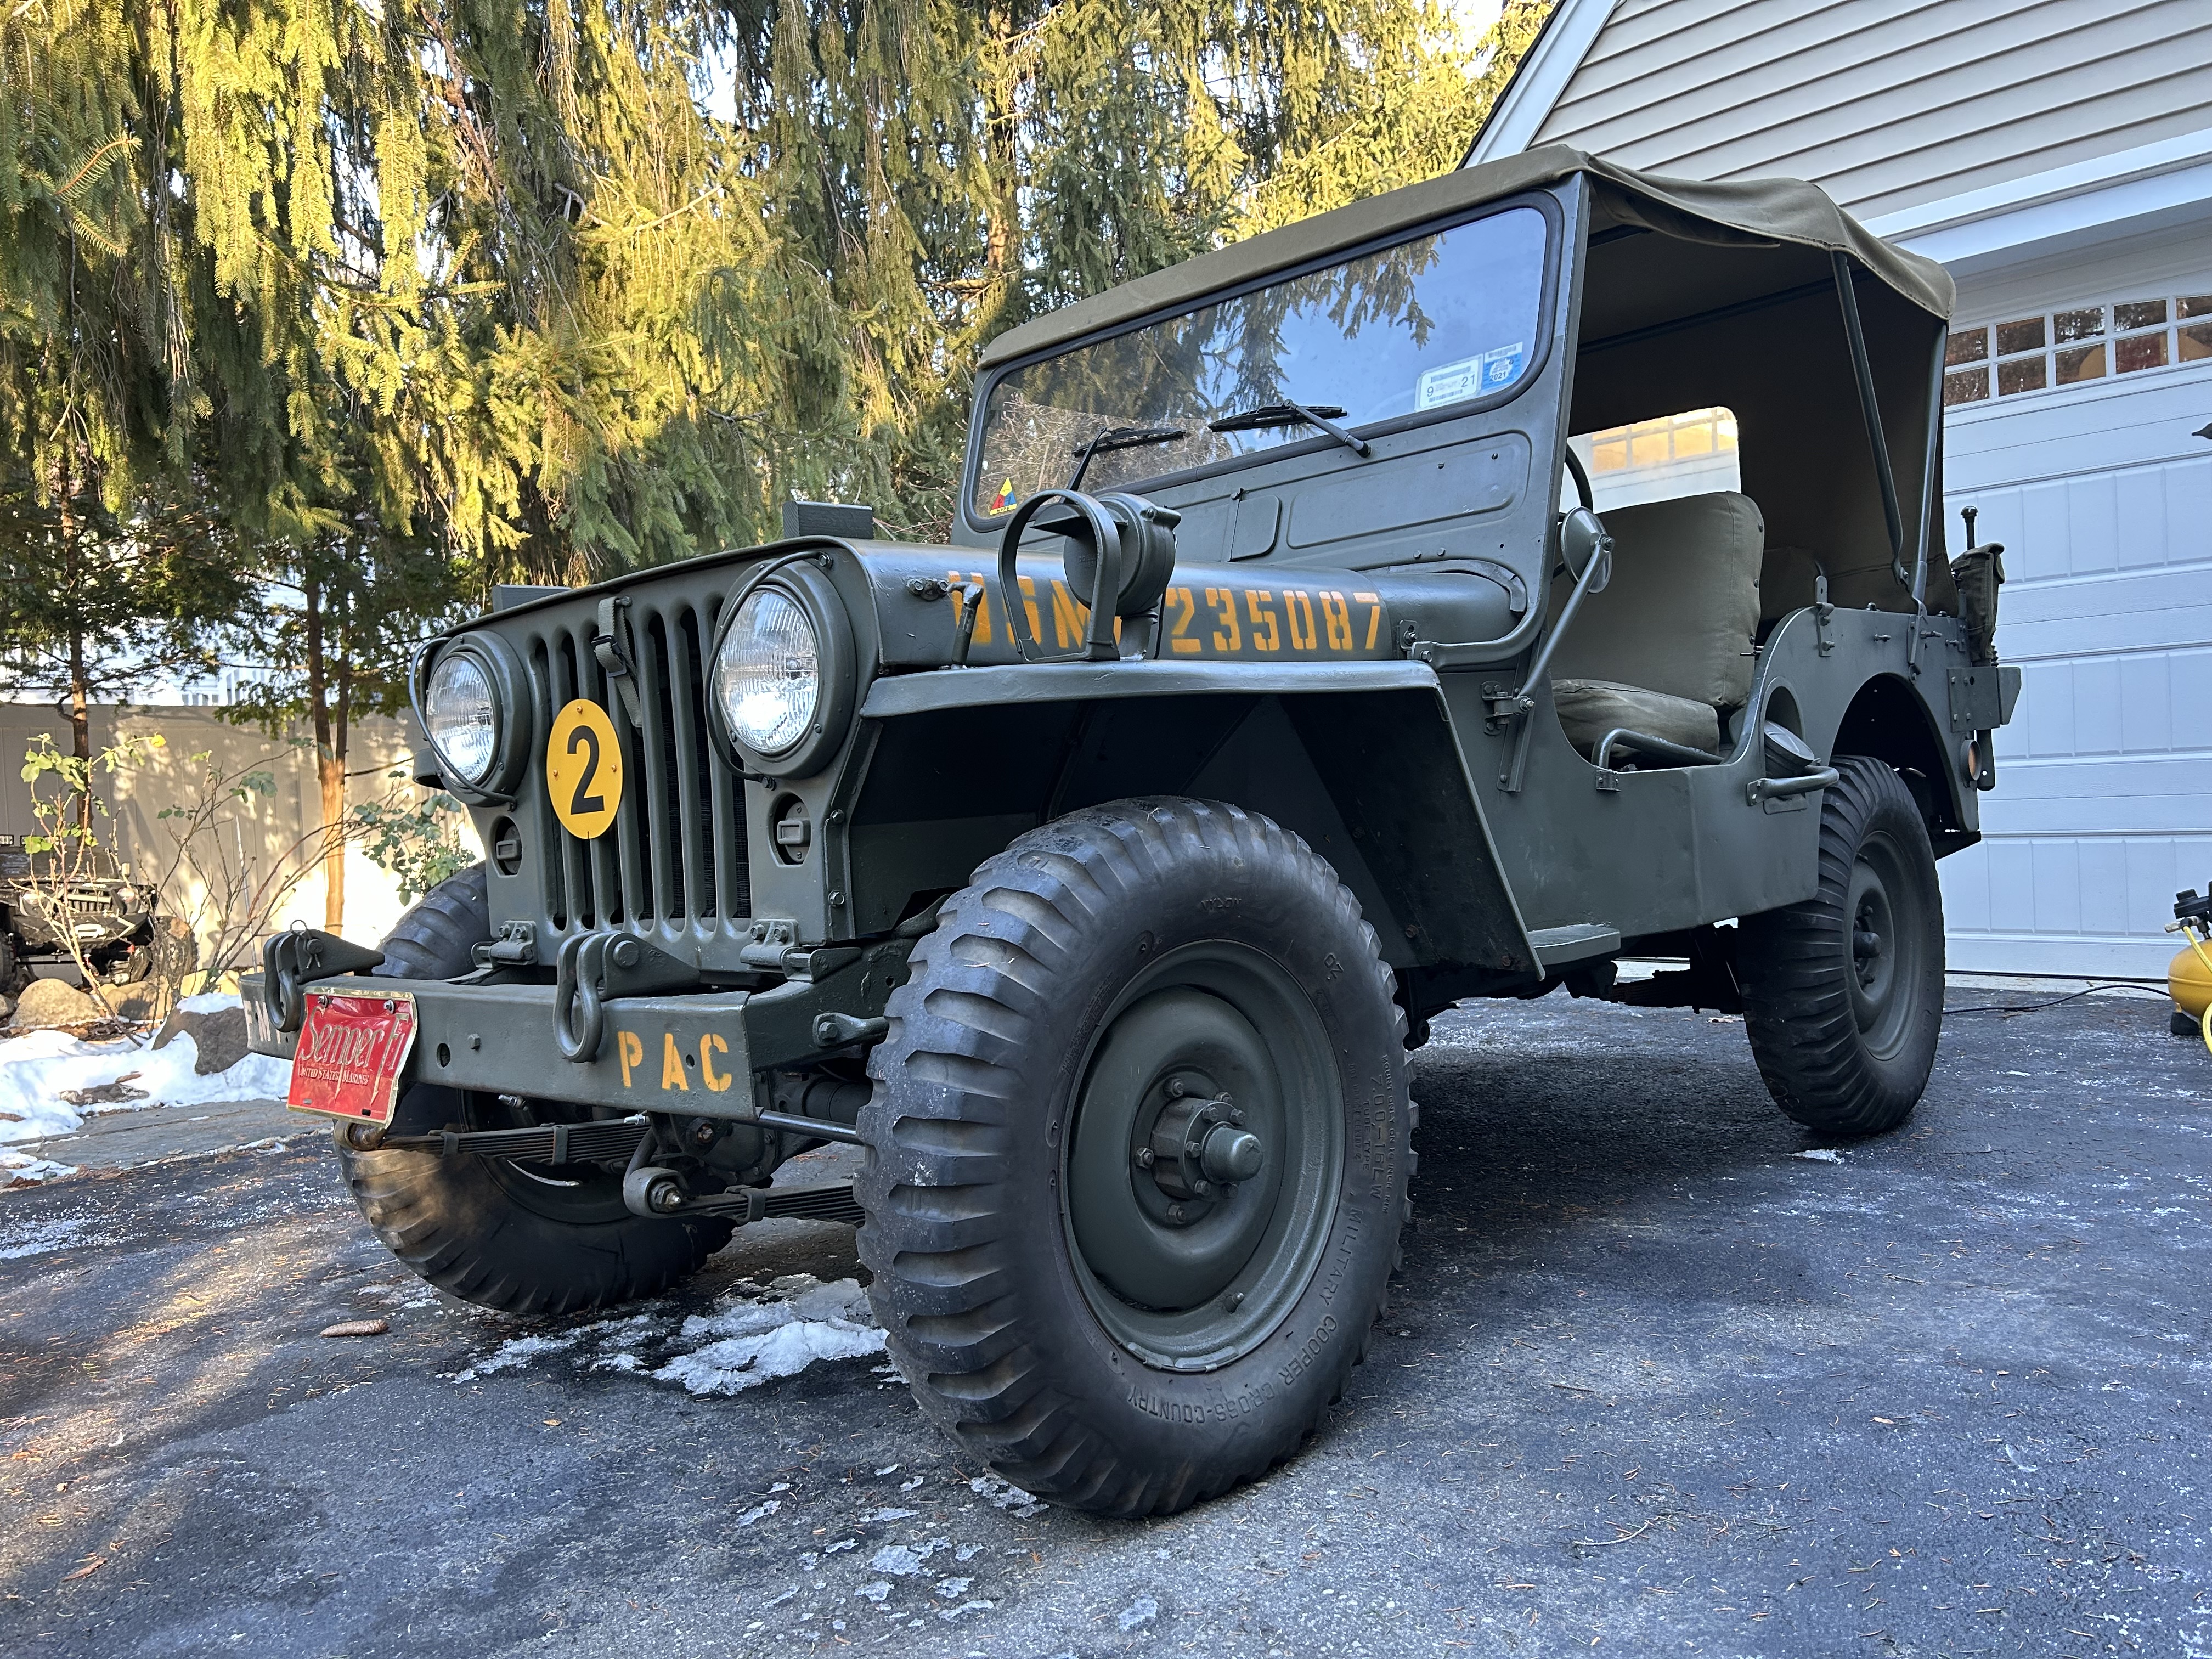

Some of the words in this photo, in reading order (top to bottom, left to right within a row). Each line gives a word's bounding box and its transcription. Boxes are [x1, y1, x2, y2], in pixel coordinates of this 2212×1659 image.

[1427, 386, 1434, 397] 9
[1461, 374, 1475, 387] 21
[1489, 371, 1506, 381] 2021
[947, 570, 1122, 649] USM
[1166, 587, 1380, 653] 235087
[567, 725, 605, 815] 2
[298, 1005, 385, 1101] Semper
[1381, 1054, 1393, 1091] MOUNT
[1362, 1100, 1372, 1132] TUBE
[1386, 1094, 1396, 1124] ONLY
[1363, 1140, 1372, 1171] TYPE
[1386, 1163, 1395, 1189] INCH
[1320, 1207, 1363, 1306] MILITARY
[1277, 1314, 1338, 1387] COOPER
